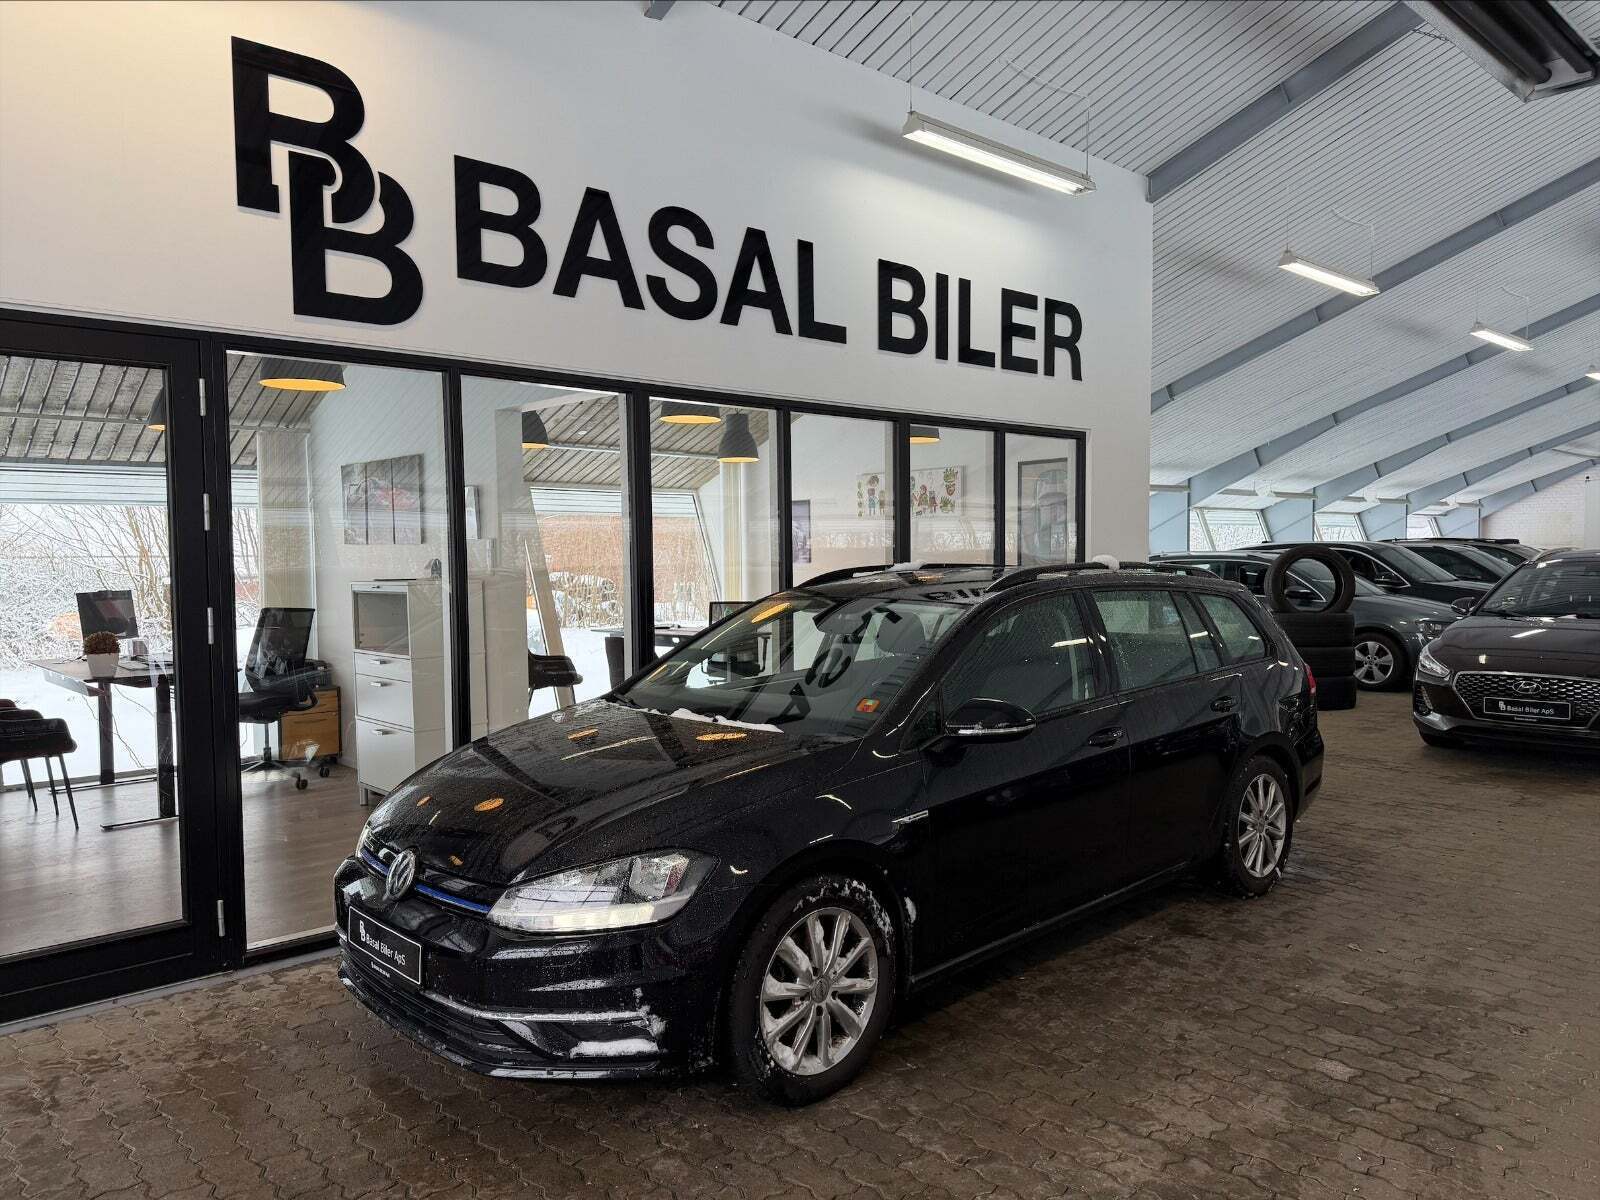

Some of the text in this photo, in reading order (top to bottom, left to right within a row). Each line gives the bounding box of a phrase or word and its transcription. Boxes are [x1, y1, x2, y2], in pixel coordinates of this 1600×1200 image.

[454, 154, 1083, 381] BASAL BILER
[1525, 706, 1540, 714] Biler
[366, 933, 406, 966] Basal Biler ApS
